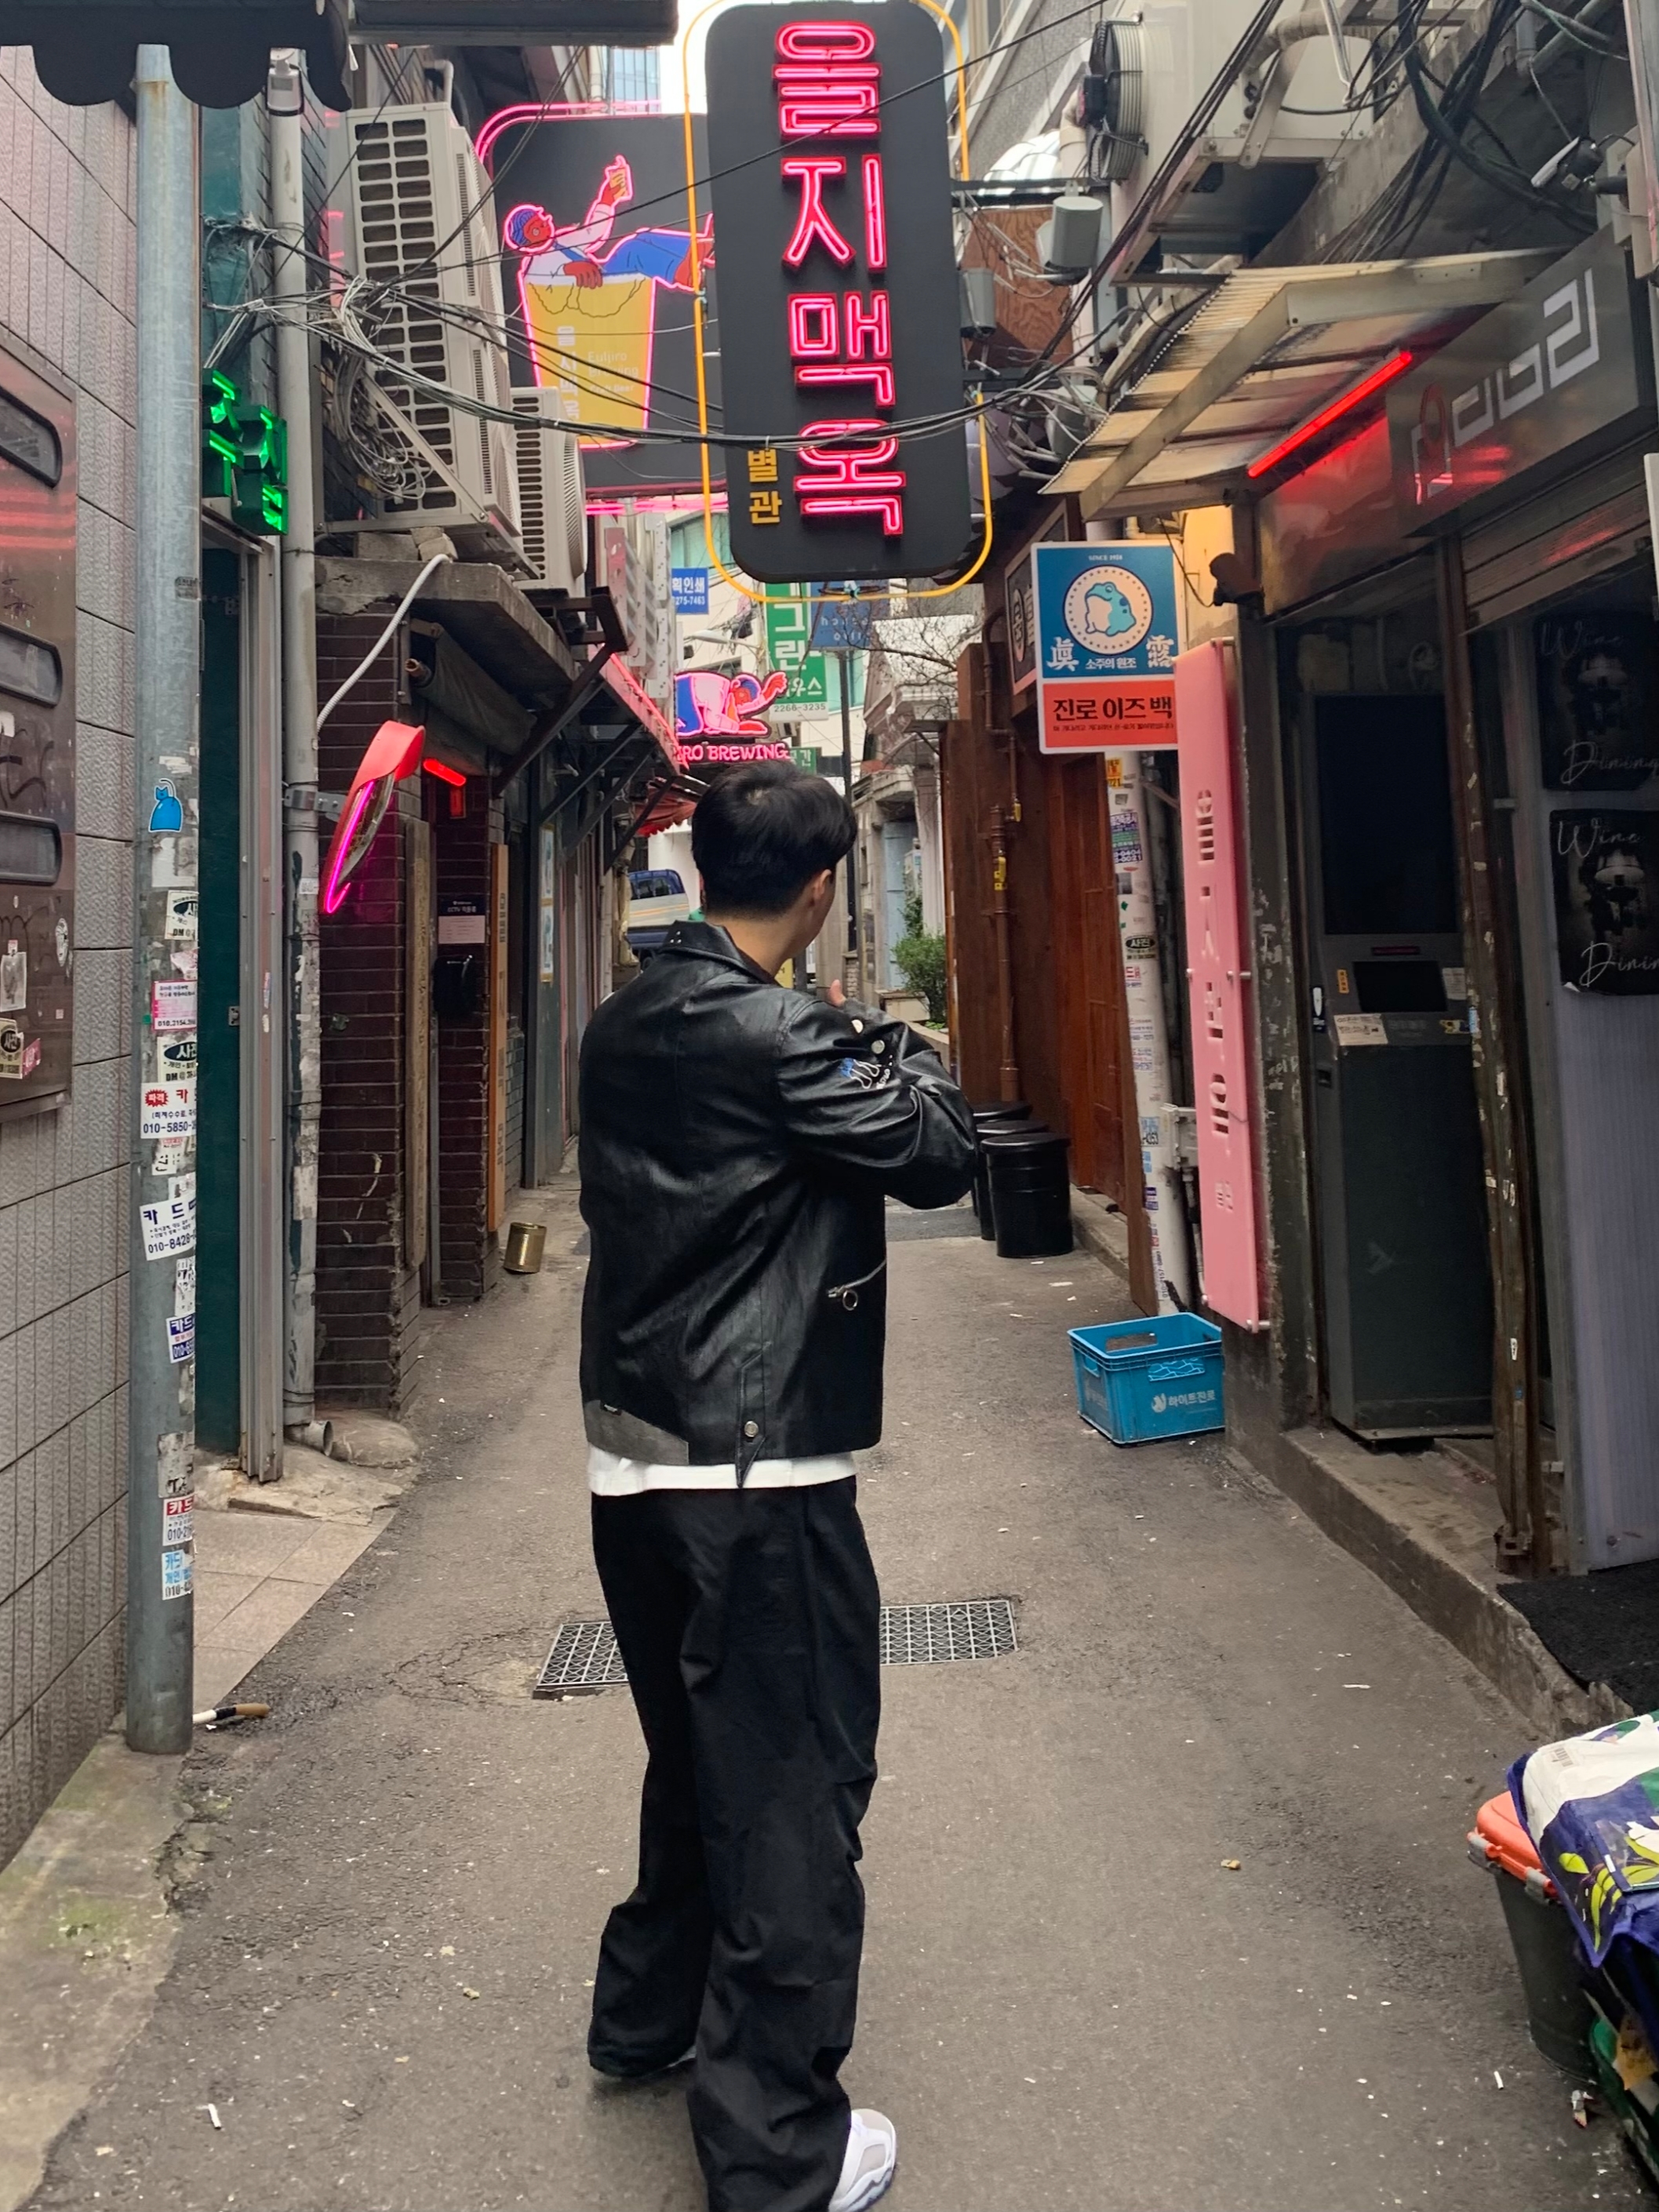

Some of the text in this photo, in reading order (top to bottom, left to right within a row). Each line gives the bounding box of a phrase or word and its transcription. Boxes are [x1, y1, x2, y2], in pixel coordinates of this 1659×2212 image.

[773, 19, 905, 536] 을지맥옥
[748, 449, 782, 525] 별관
[1053, 696, 1173, 722] 진로 이즈 백
[707, 743, 791, 762] BREWING
